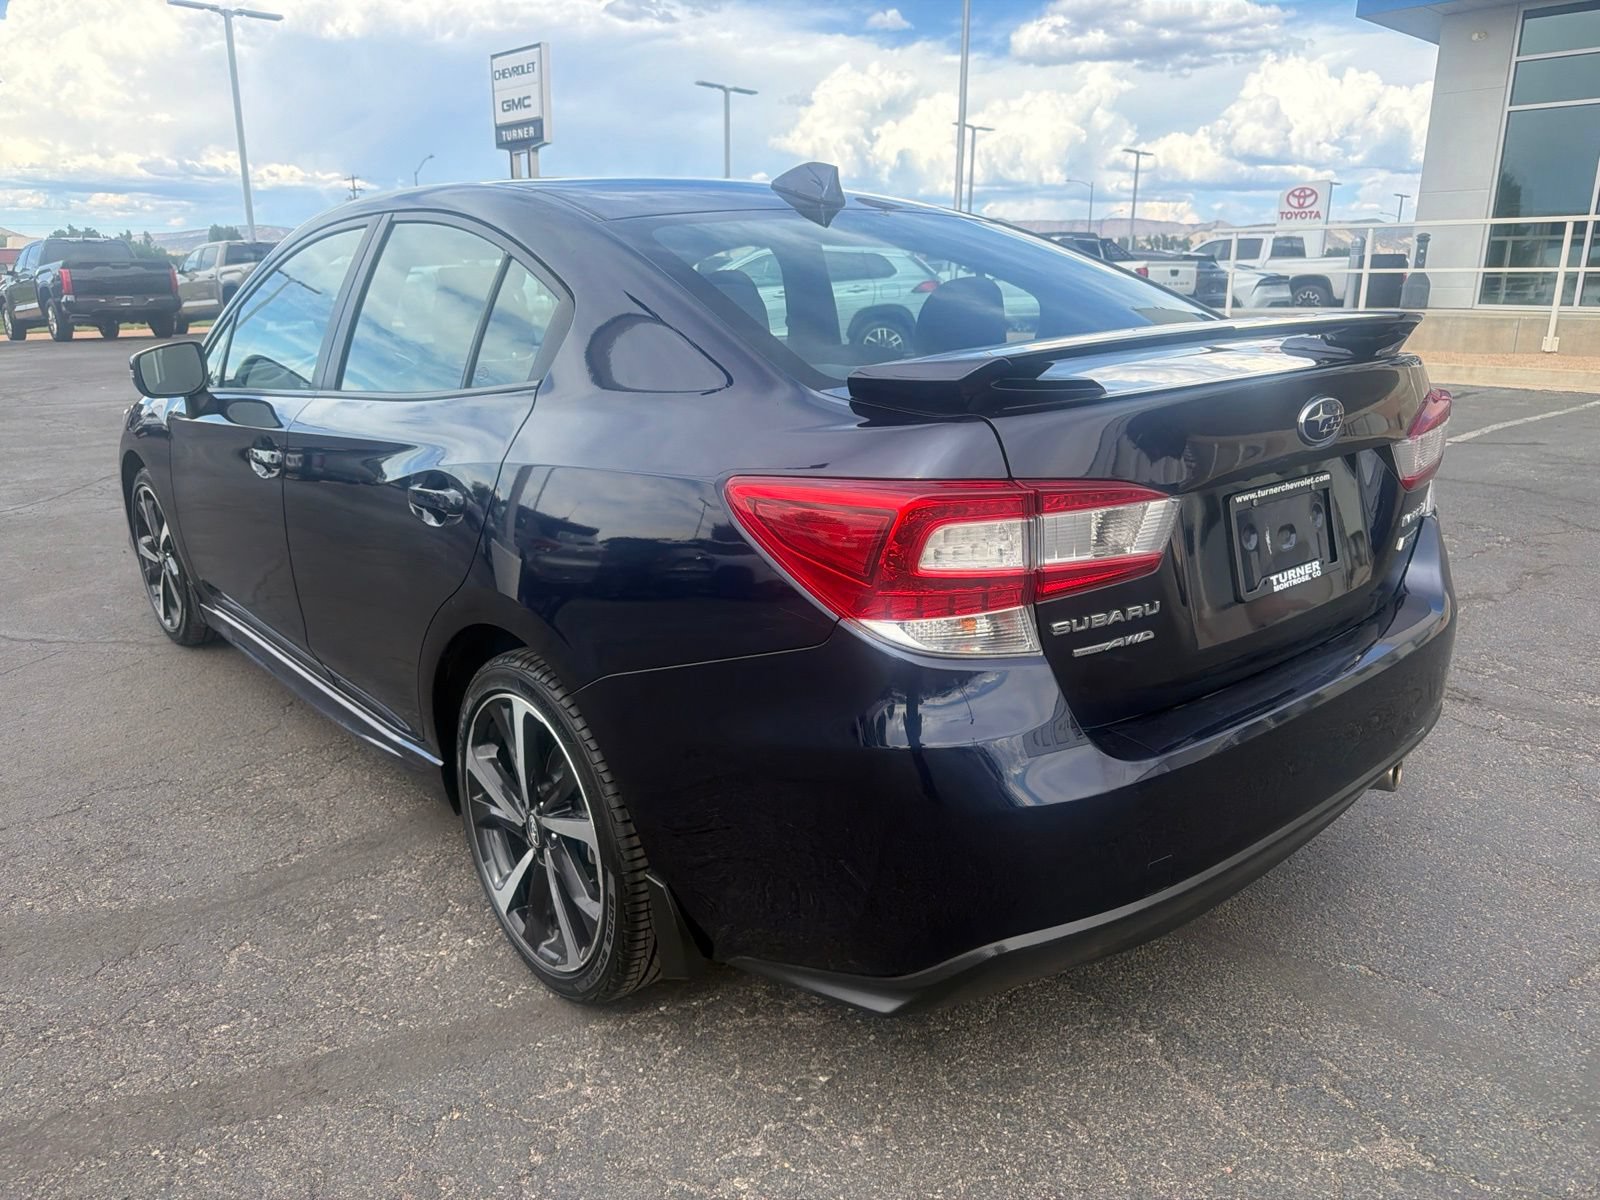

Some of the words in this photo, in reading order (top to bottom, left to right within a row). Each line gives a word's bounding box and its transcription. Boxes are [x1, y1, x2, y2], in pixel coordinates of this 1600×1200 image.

[493, 62, 536, 81] CHEVROLET
[501, 95, 532, 113] GMC
[501, 126, 535, 141] TURNER
[1280, 210, 1322, 220] TOYOTA
[1235, 473, 1331, 503] www.turnerchevrolet.com
[1269, 560, 1321, 586] TURNER
[1312, 570, 1322, 578] CO
[1051, 600, 1161, 636] SUBARU
[1105, 630, 1155, 651] AWD
